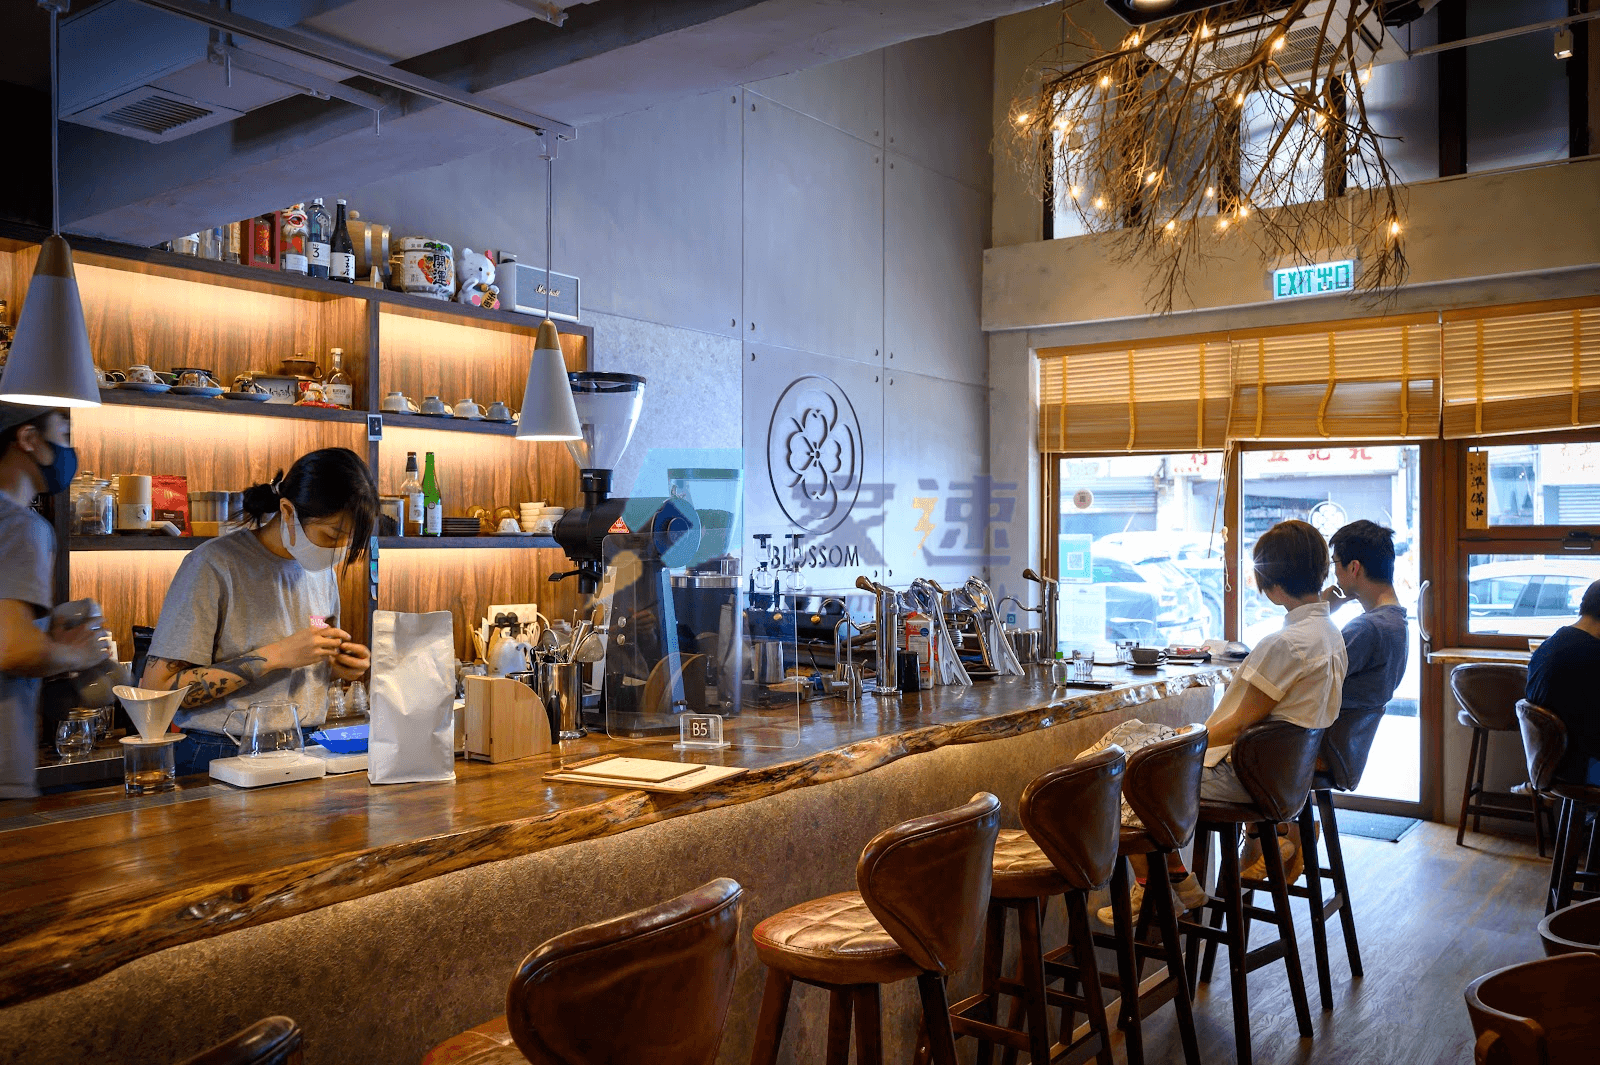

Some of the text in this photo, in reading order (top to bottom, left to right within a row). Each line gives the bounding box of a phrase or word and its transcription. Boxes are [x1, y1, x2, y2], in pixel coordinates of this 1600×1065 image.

[433, 254, 447, 287] 開運
[1277, 264, 1350, 297] EXIT 出口
[534, 284, 561, 297] Mahall
[692, 722, 708, 736] B5
